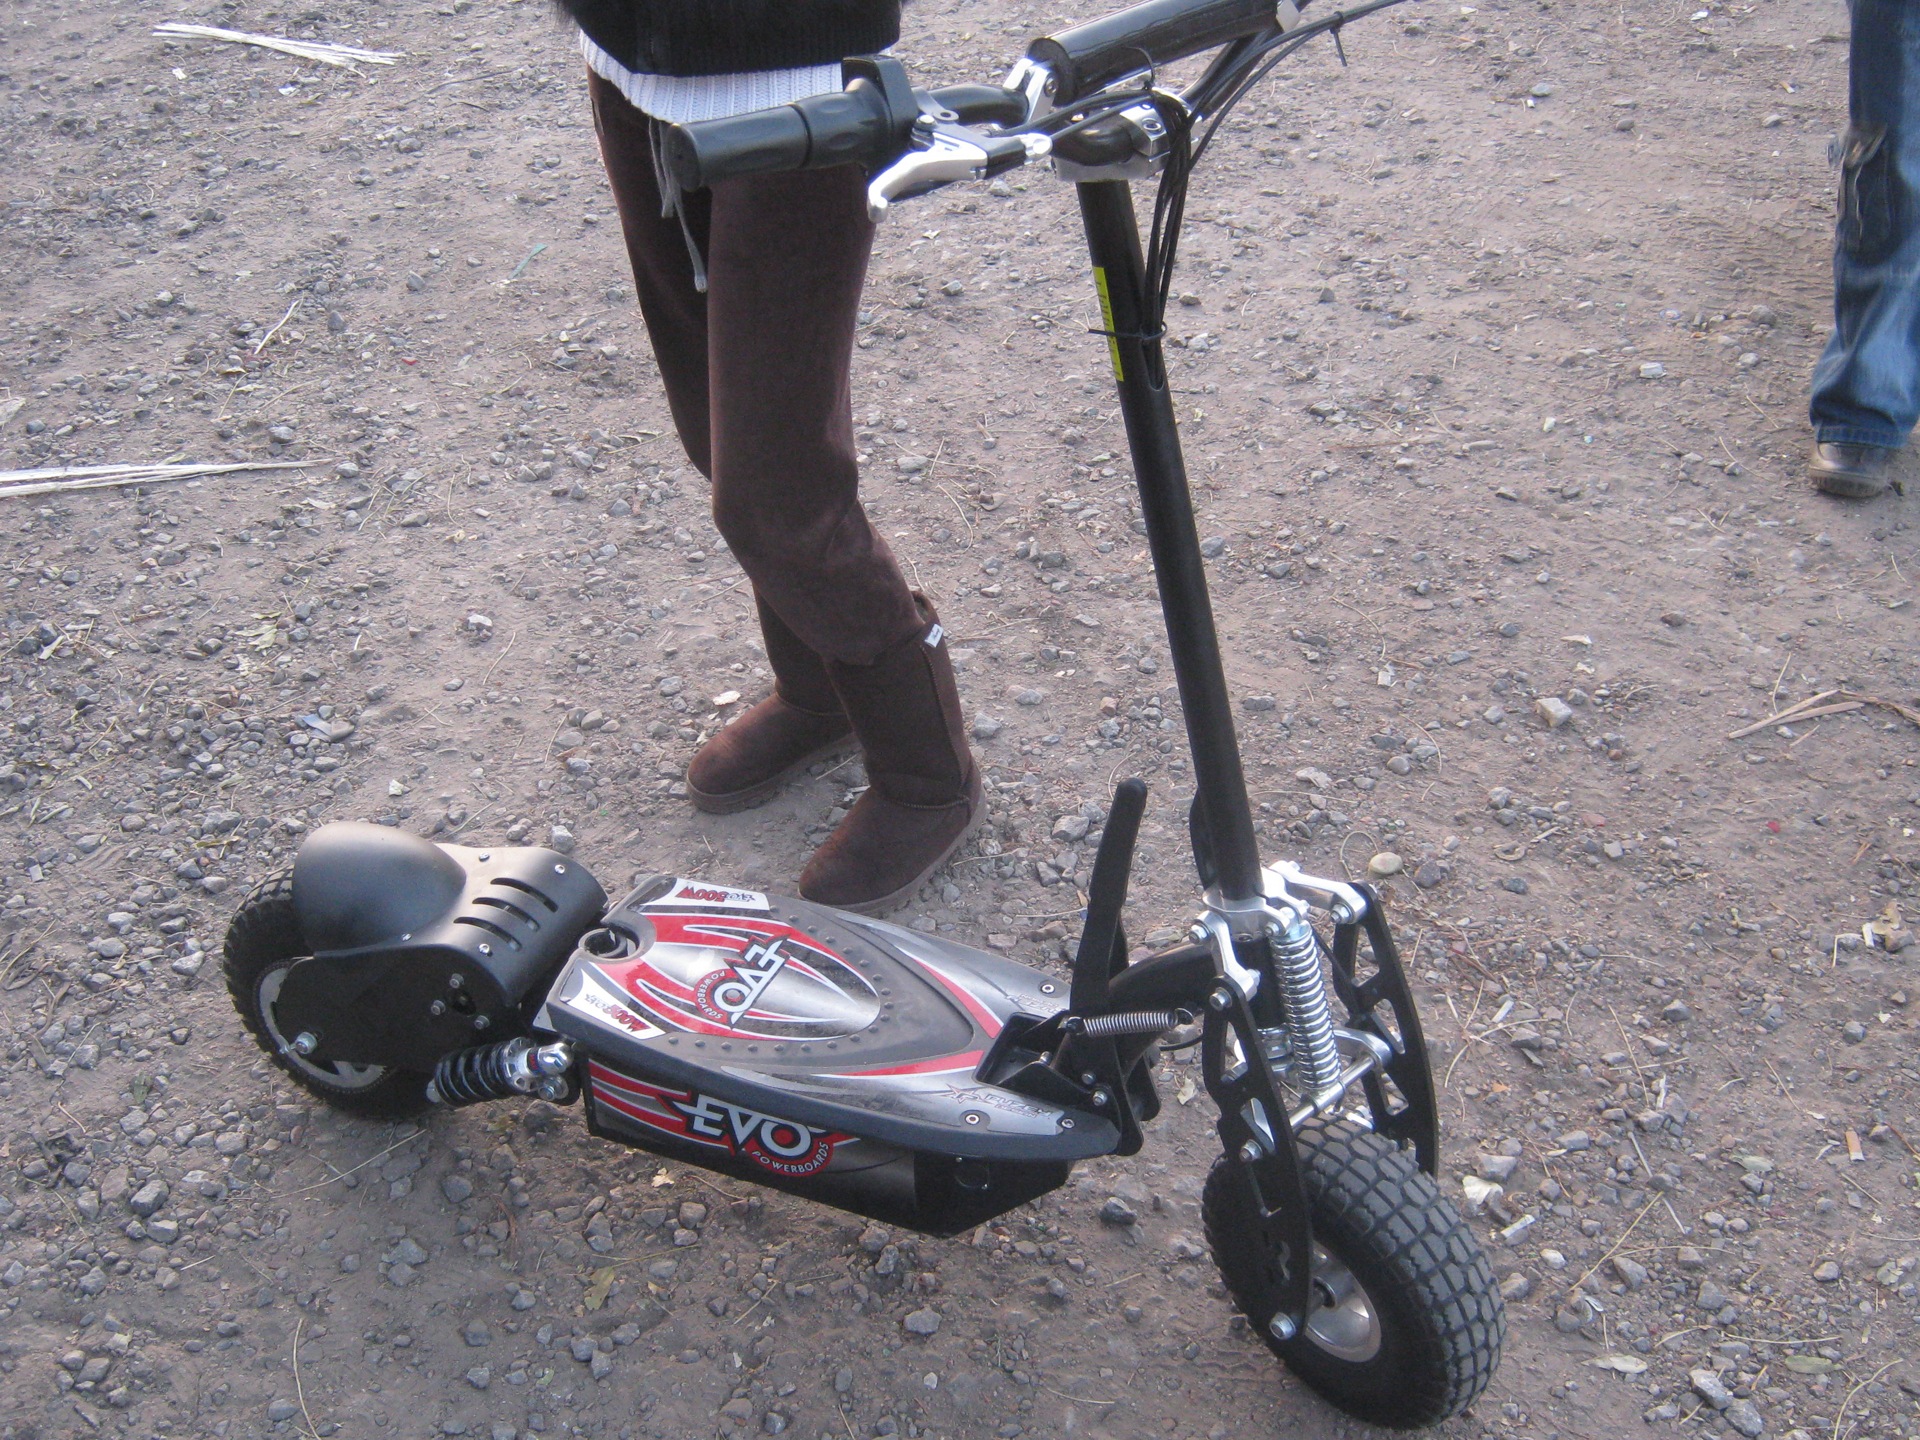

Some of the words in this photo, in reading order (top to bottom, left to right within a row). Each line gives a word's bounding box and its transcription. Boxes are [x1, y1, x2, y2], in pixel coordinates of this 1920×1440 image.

[697, 970, 726, 1020] POWERBOARDS
[714, 939, 786, 1025] EVO
[672, 1093, 828, 1158] EVO
[752, 1141, 830, 1174] POWERBOARDS
